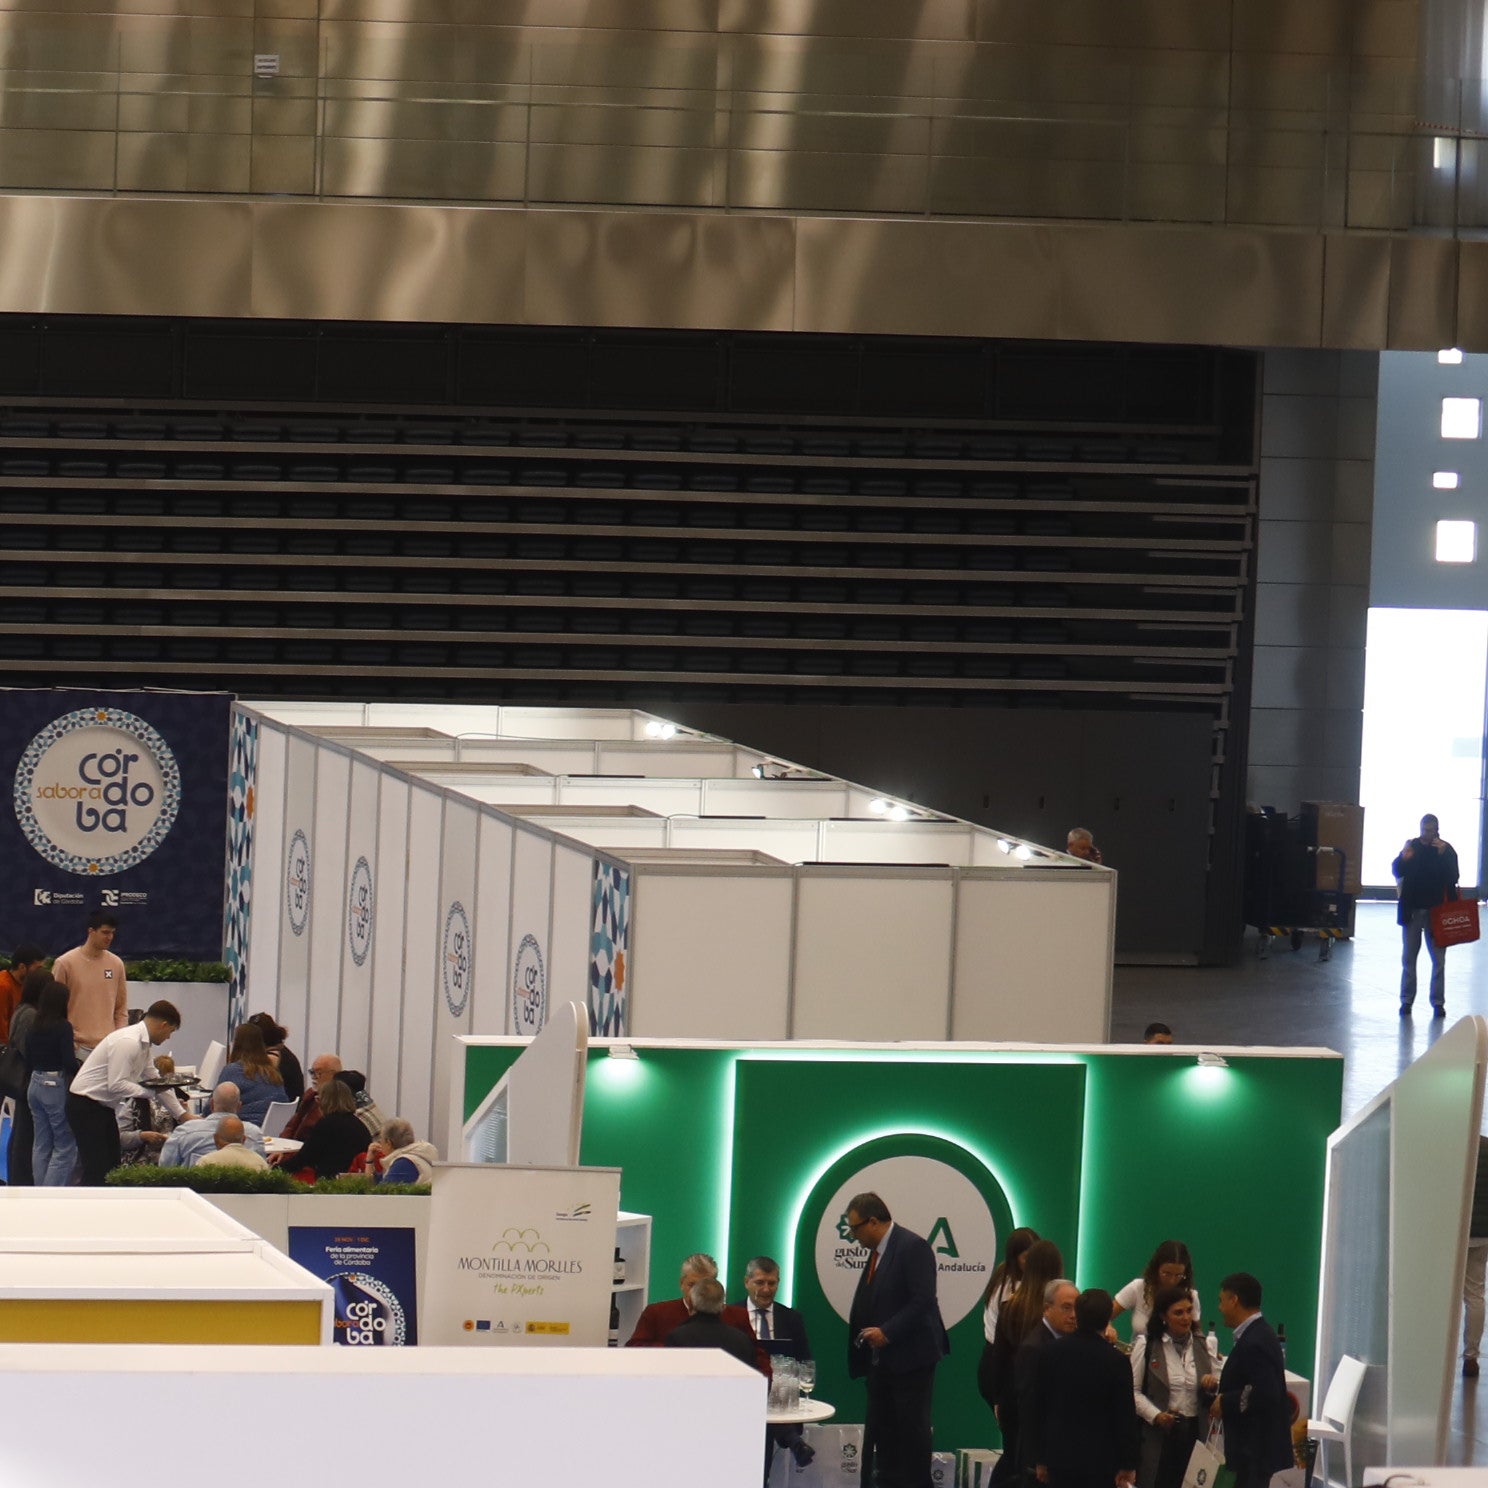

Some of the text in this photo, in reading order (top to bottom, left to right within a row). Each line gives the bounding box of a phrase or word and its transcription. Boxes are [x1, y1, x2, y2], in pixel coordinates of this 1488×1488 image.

[36, 783, 86, 800] sabor
[343, 1246, 379, 1254] alimentaria
[834, 1245, 868, 1260] gusto
[457, 1257, 521, 1271] MONTILLA
[938, 1262, 986, 1272] Andalucía
